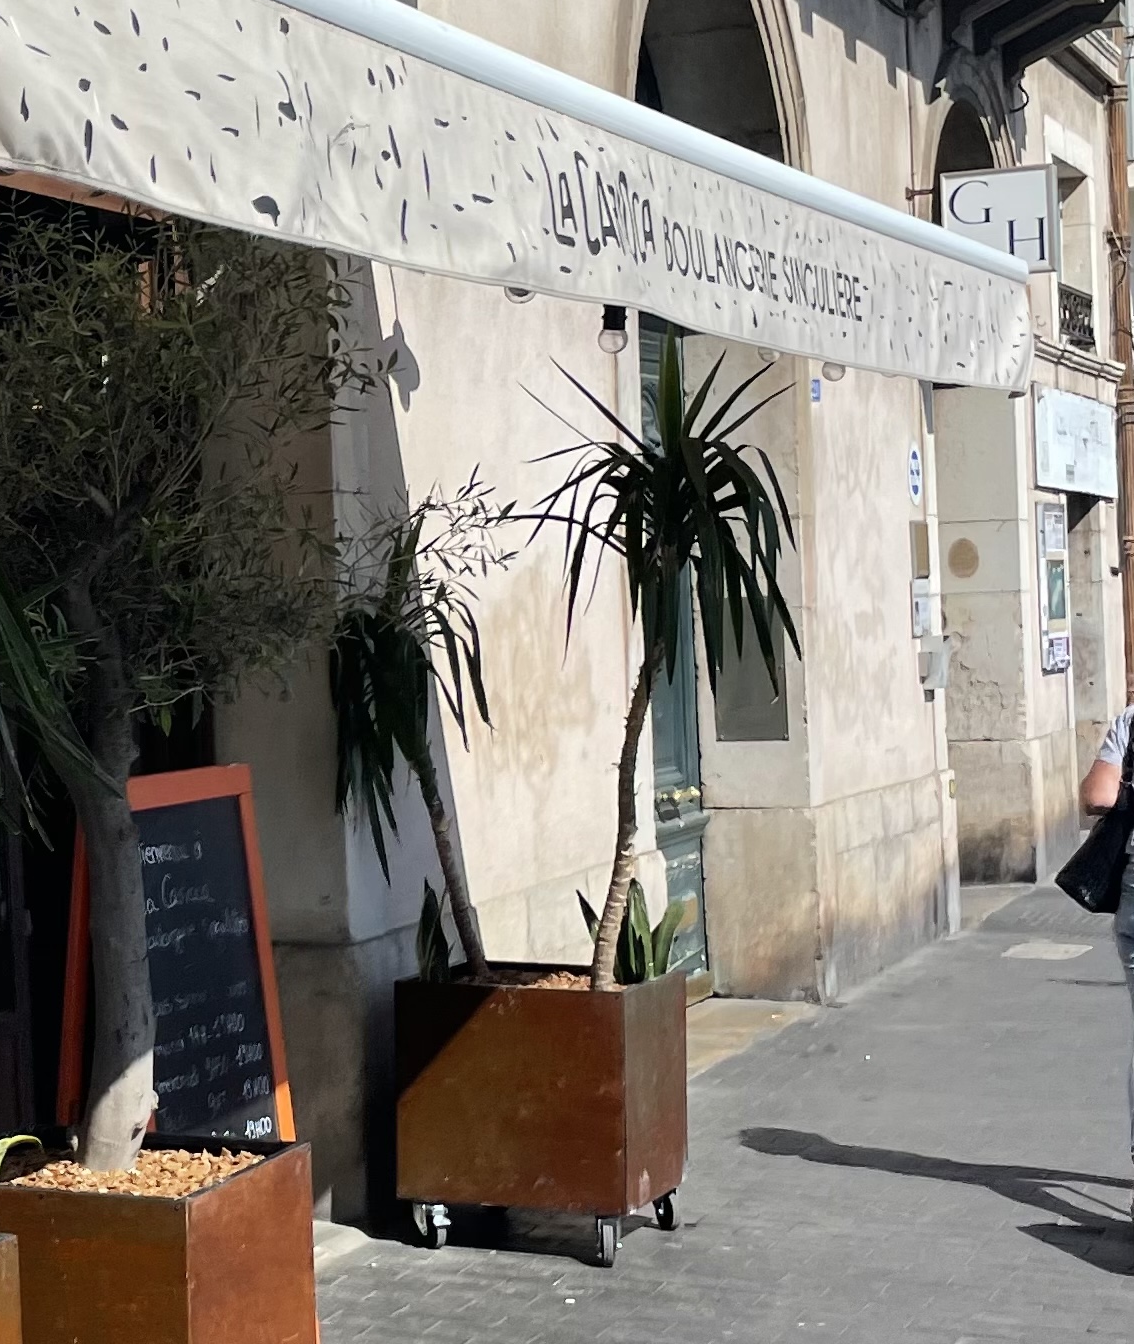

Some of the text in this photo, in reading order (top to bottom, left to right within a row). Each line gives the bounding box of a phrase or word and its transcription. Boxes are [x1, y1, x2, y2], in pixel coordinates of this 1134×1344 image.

[537, 145, 578, 248] LA
[948, 179, 993, 226] G
[1006, 216, 1047, 262] H
